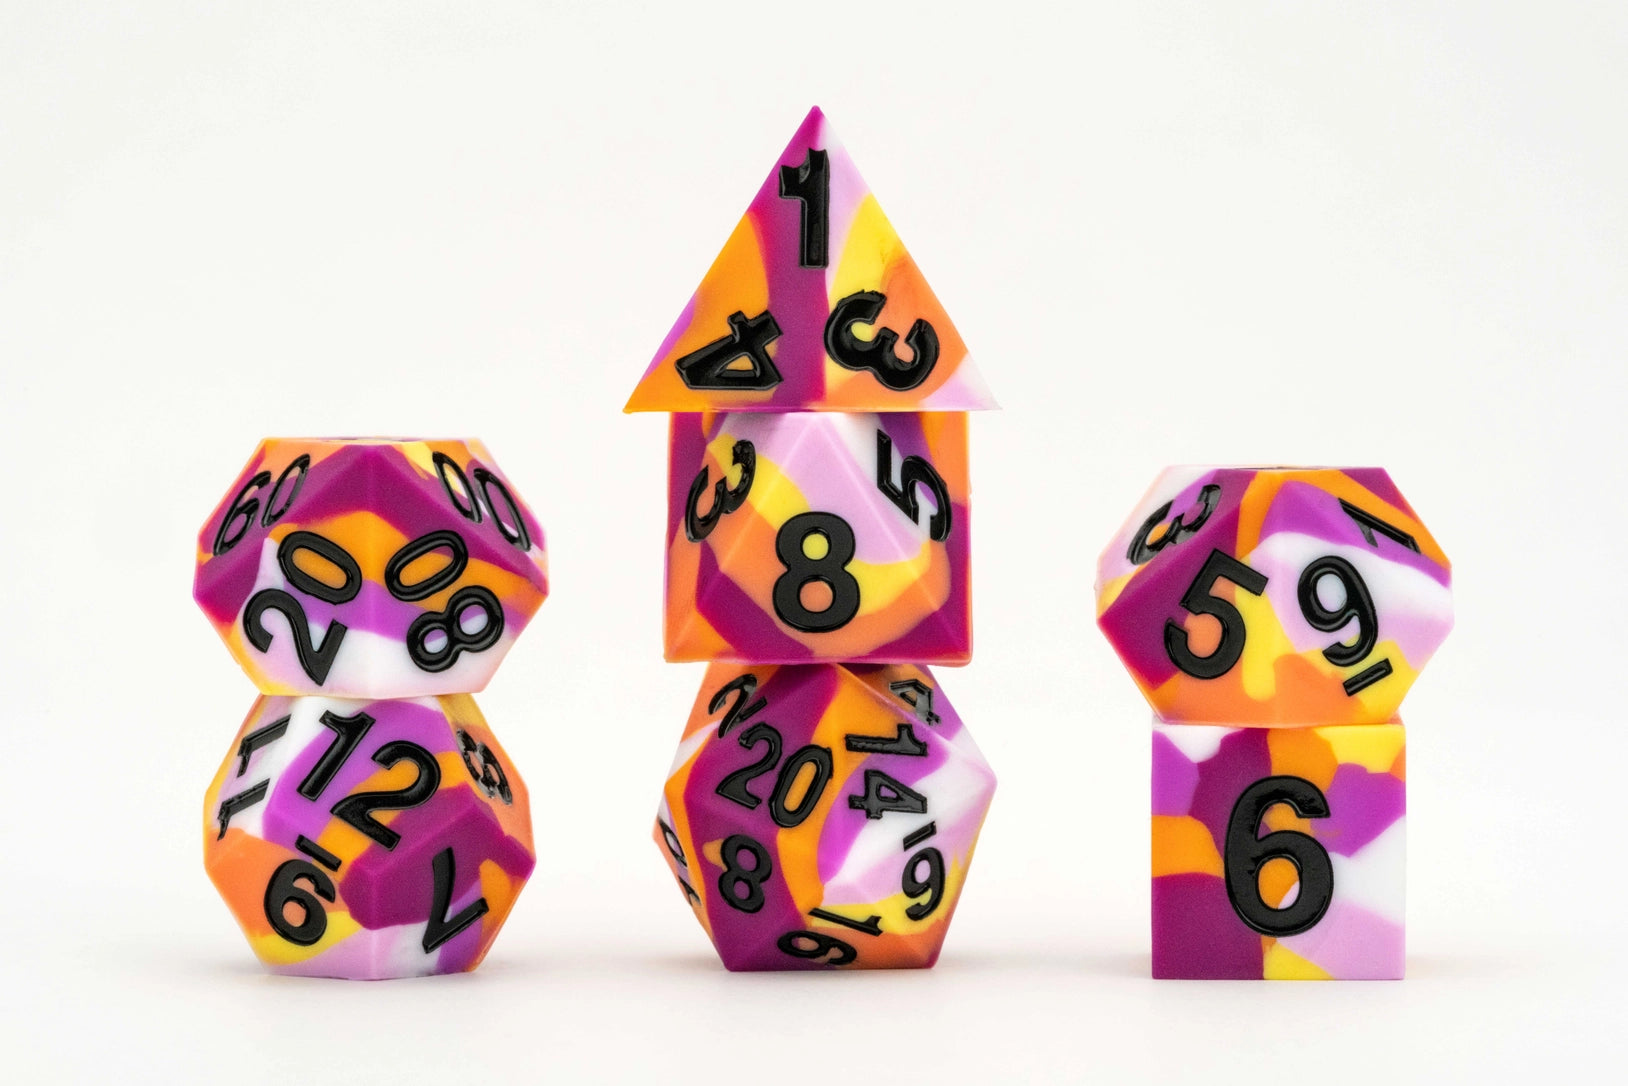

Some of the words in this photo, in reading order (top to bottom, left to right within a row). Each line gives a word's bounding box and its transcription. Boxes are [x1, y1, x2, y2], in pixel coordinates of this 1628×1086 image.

[778, 147, 830, 269] 1
[675, 309, 784, 391] 4
[823, 289, 940, 392] 3
[214, 454, 312, 556] 60
[433, 452, 531, 551] 00
[684, 439, 756, 543] 3
[876, 428, 953, 542] 5
[1128, 483, 1221, 565] 3
[242, 530, 363, 687] 20
[773, 511, 861, 634] 8
[1163, 547, 1269, 680] 5
[708, 673, 768, 739] 2
[297, 710, 442, 852] 12
[714, 721, 834, 829] 20
[845, 723, 928, 820] 14
[421, 846, 489, 954] 7
[718, 834, 773, 914] 8
[1223, 775, 1335, 938] 6
